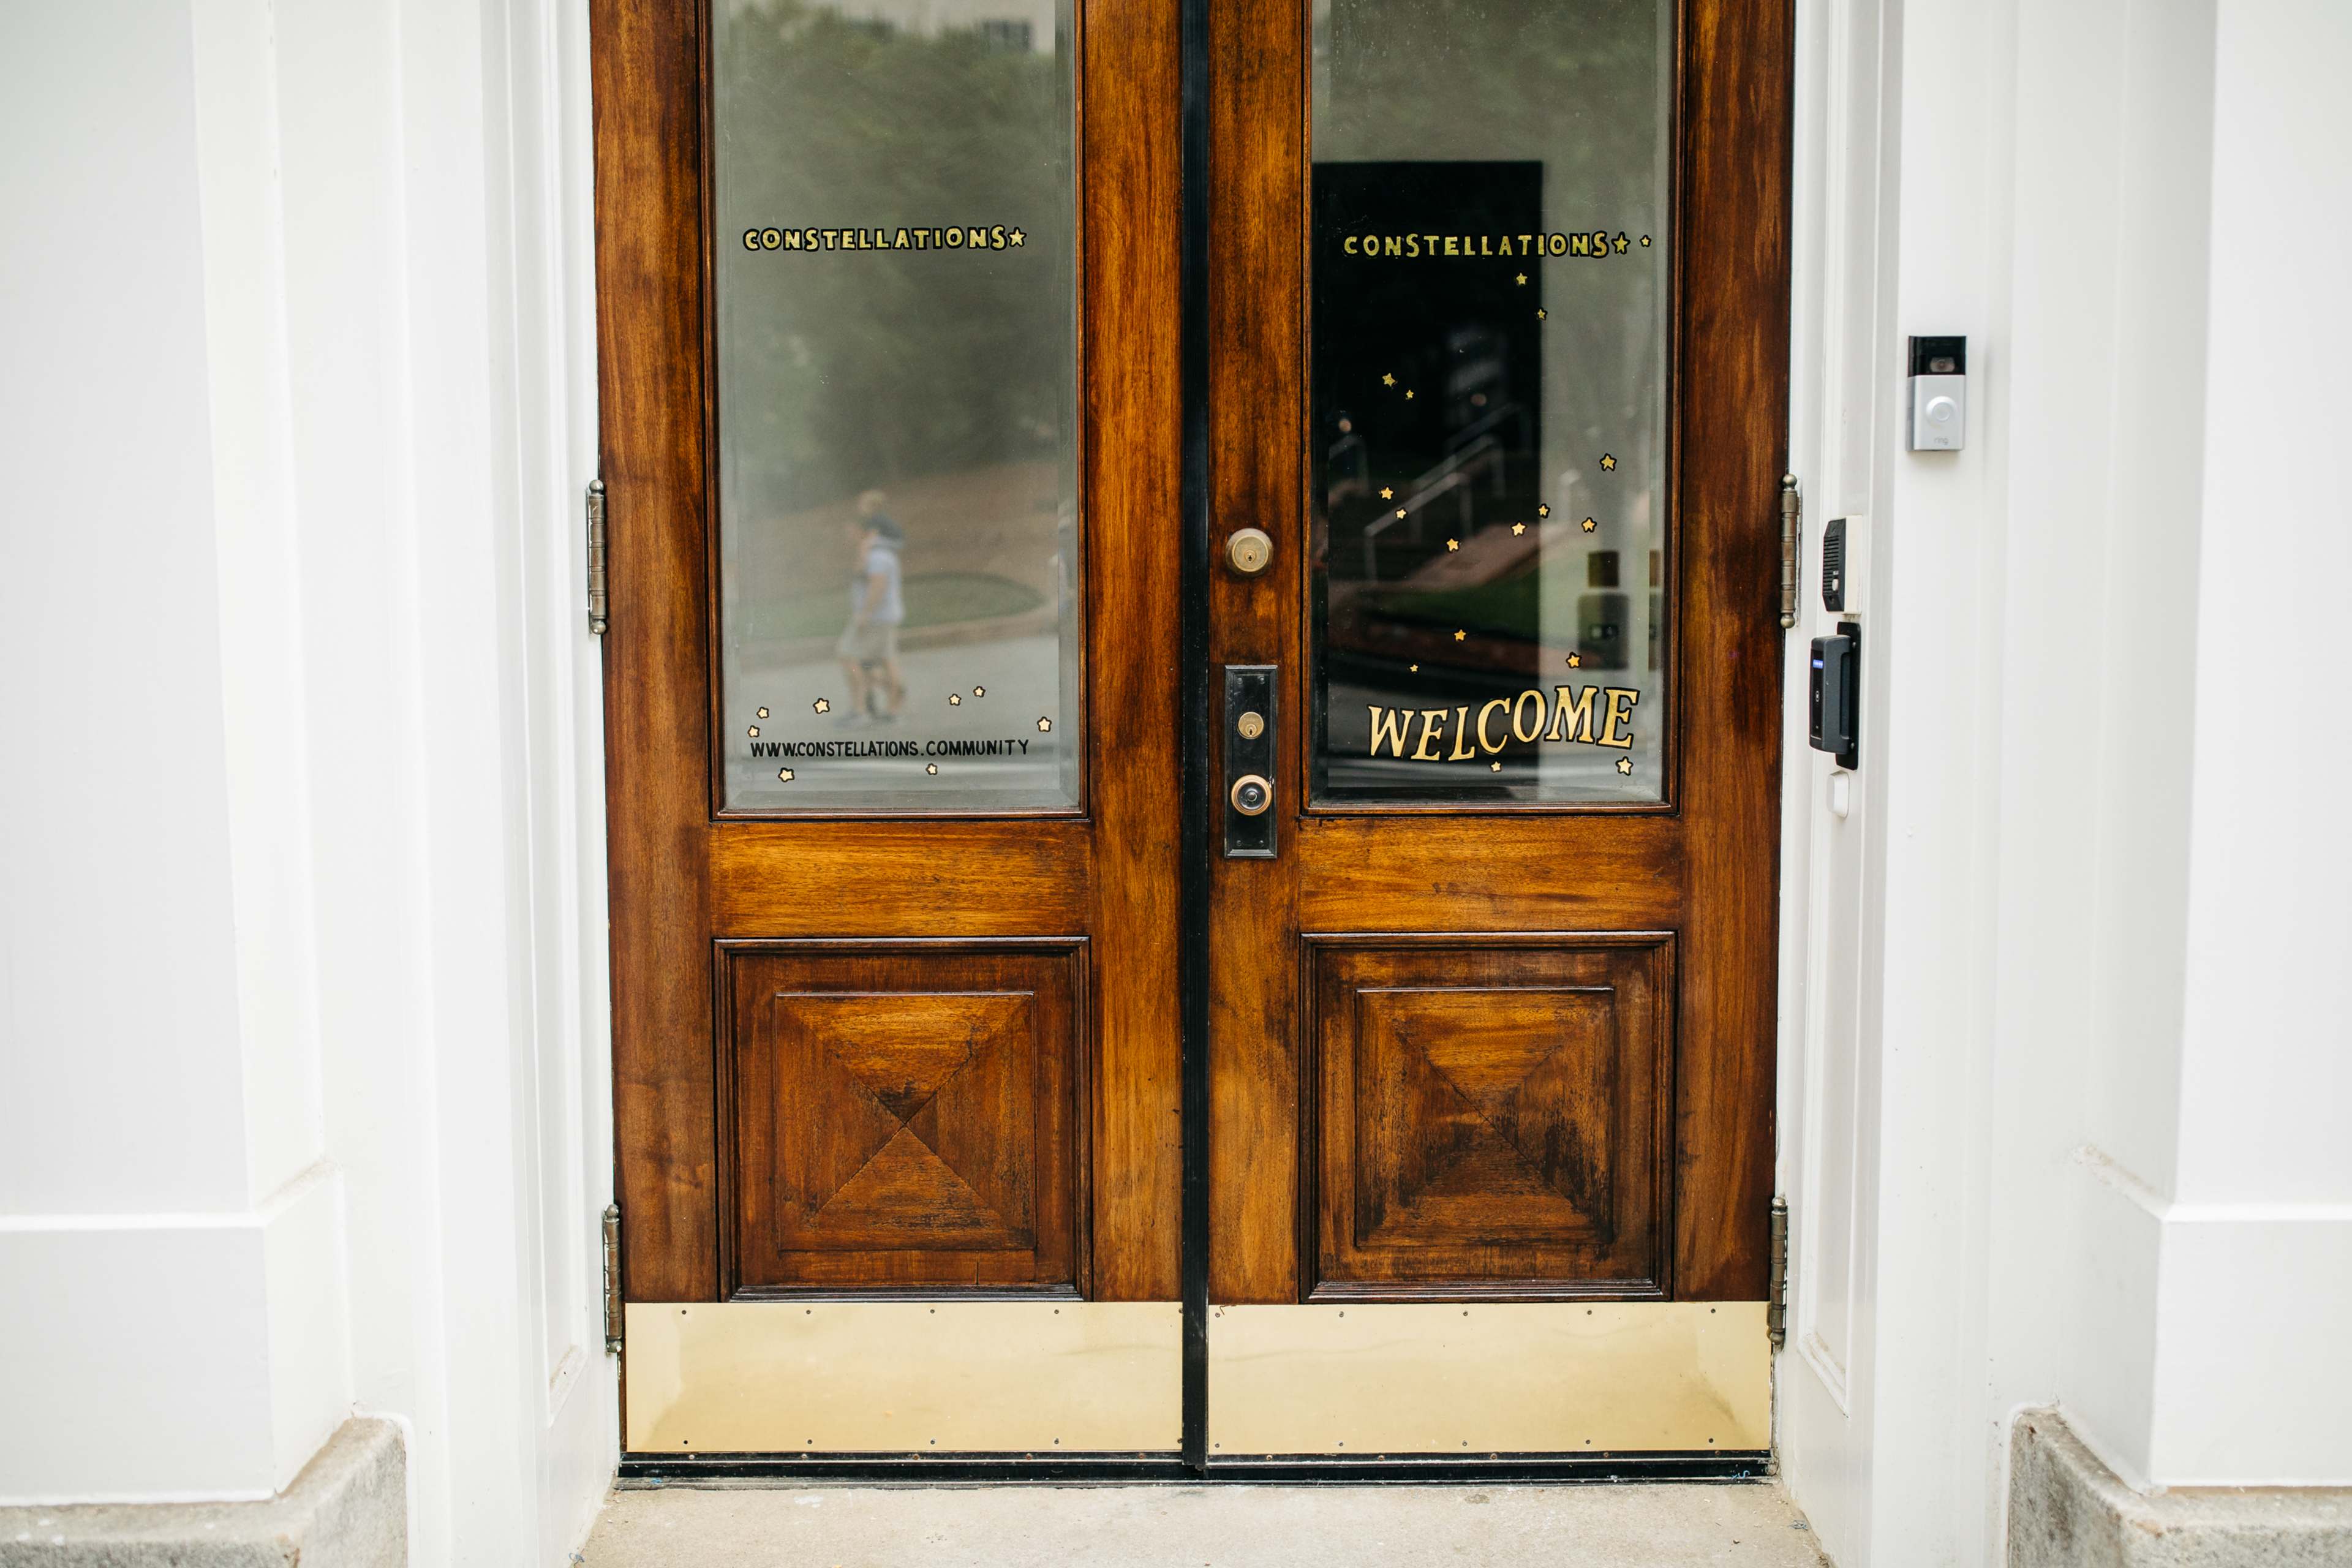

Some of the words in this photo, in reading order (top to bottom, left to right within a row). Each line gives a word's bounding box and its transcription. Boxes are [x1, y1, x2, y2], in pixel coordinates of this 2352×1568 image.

[743, 225, 1005, 252] CONSTELLATIONS
[1343, 230, 1608, 258] CONSTELLATIONS
[1366, 685, 1641, 761] WELCOME
[750, 739, 1030, 758] WWW.CONSTELLATIONS.COMMUNITY
